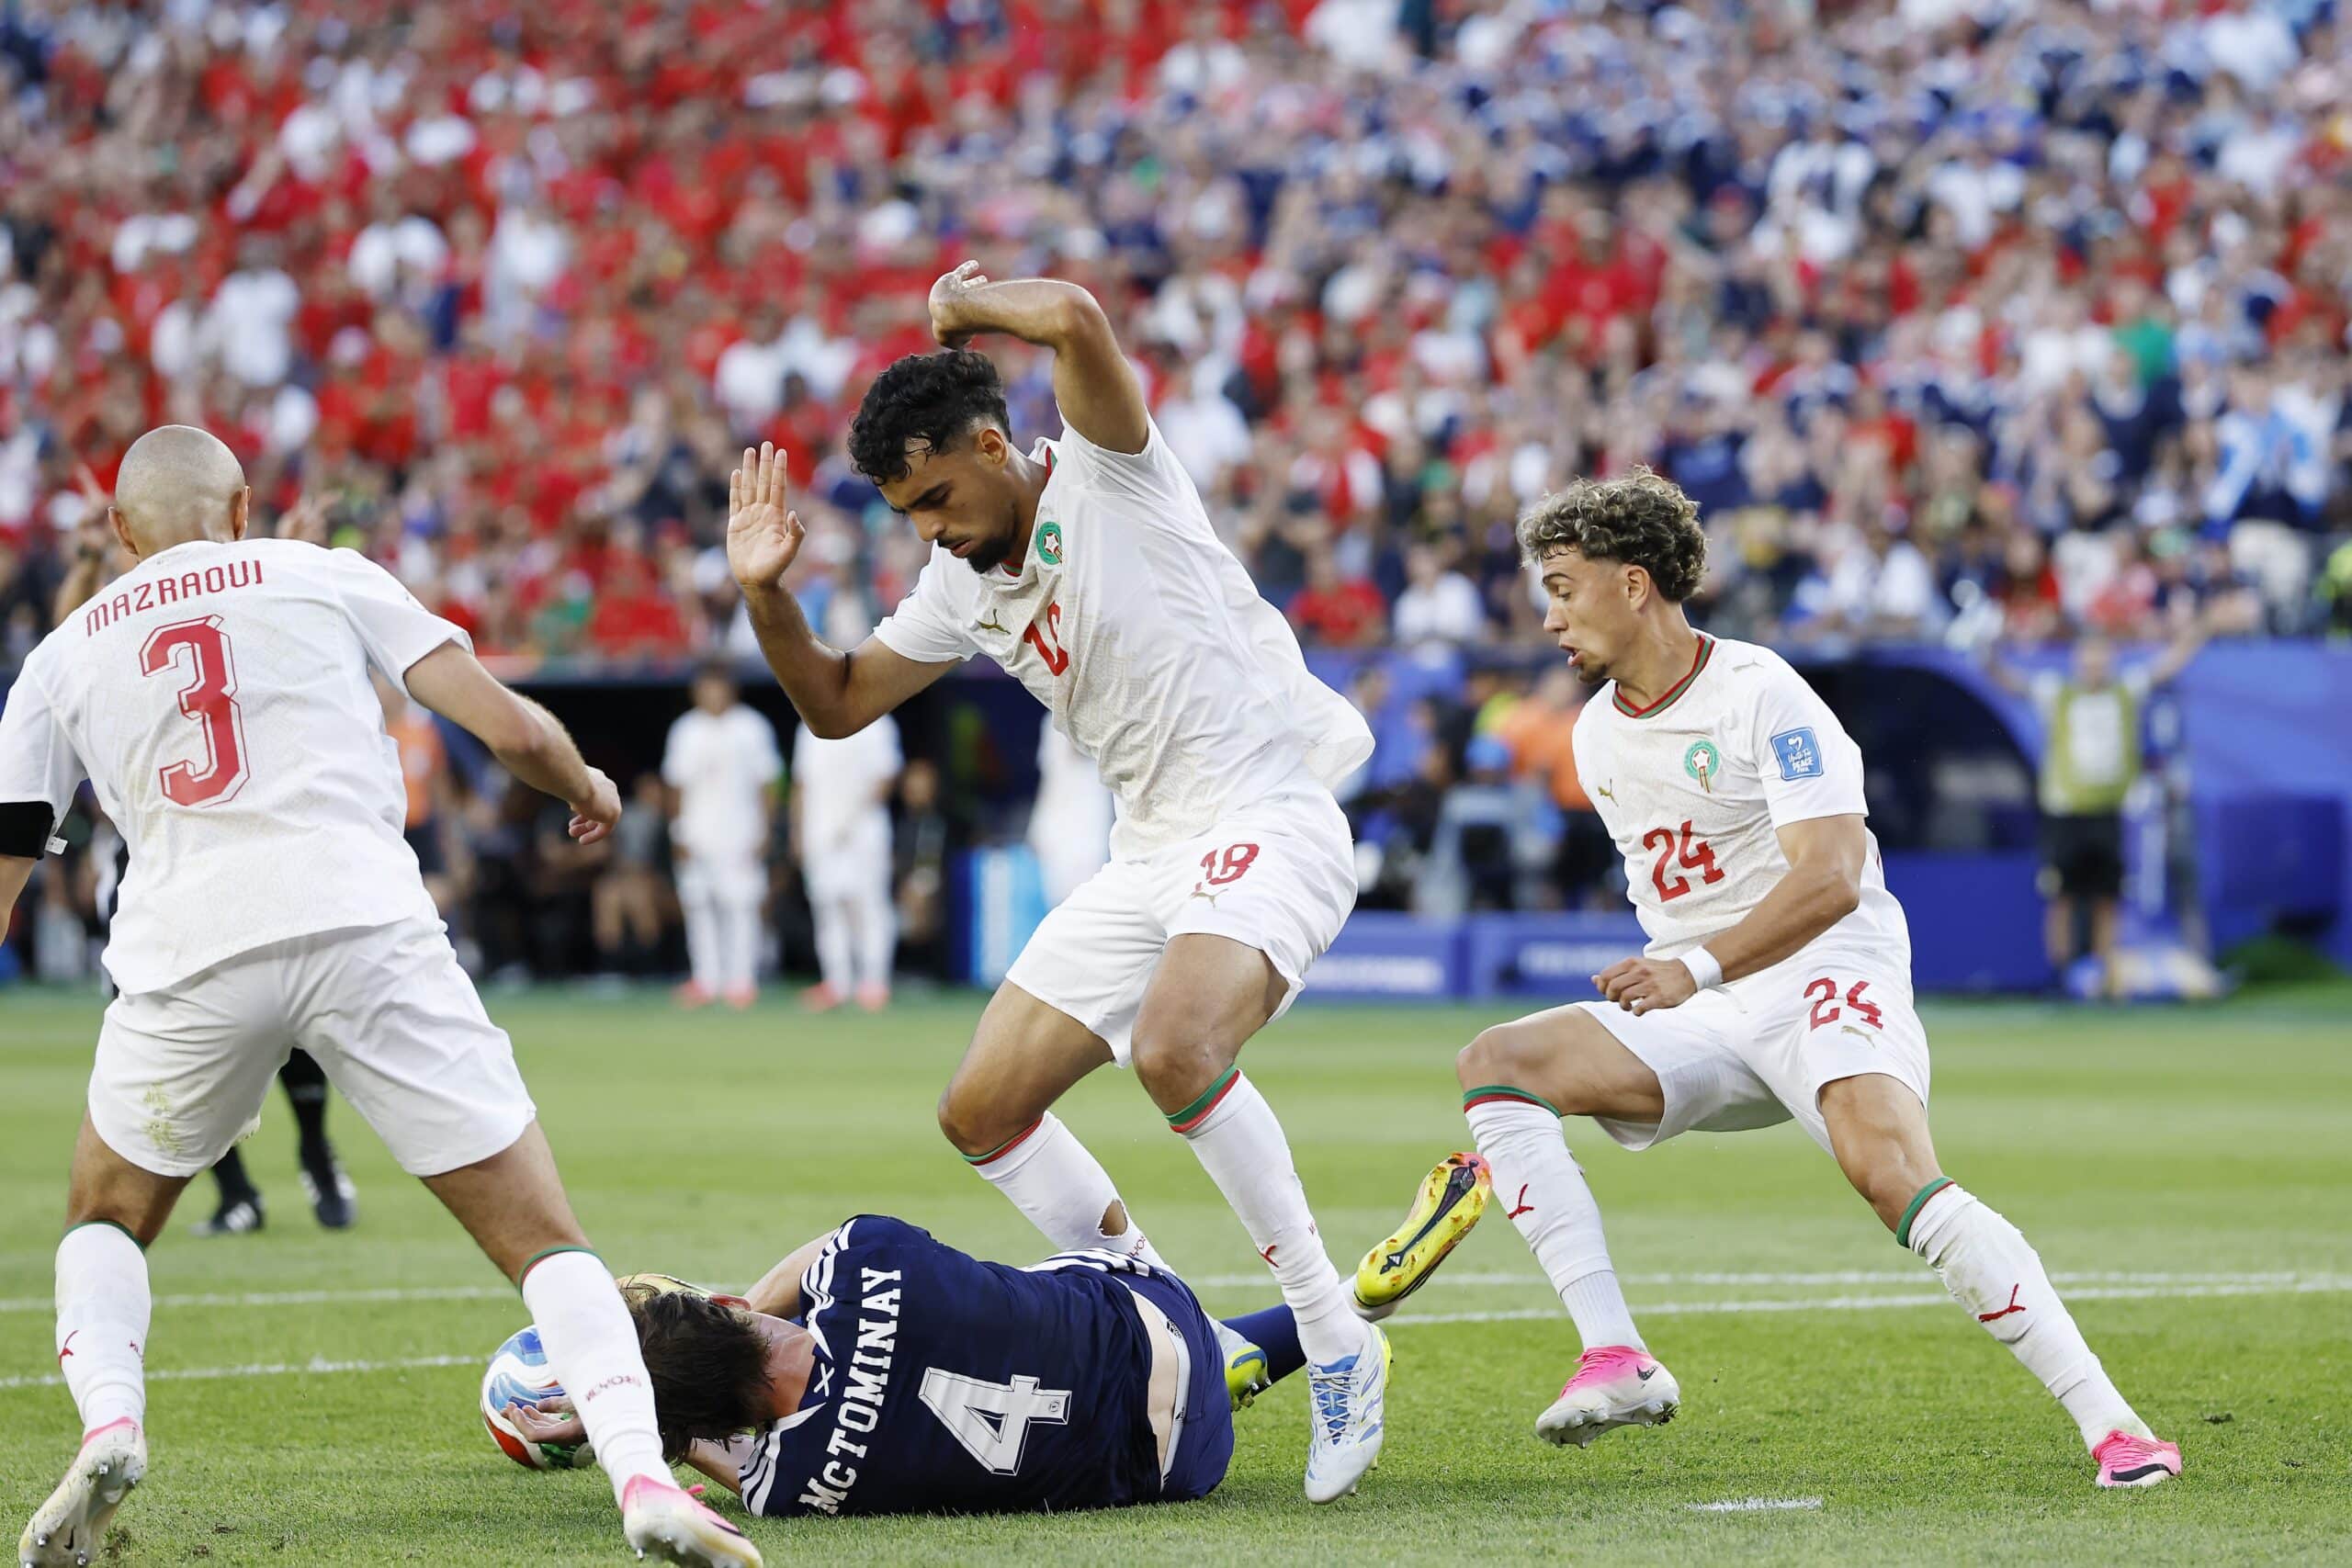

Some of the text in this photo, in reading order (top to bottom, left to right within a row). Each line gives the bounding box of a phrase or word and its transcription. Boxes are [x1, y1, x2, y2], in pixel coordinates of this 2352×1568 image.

[85, 559, 264, 637] MAZRAOUI
[139, 614, 251, 808] 3
[1643, 819, 1725, 902] 24
[1804, 976, 1883, 1032] 24
[797, 1266, 902, 1516] MCTOMINAY
[918, 1367, 1072, 1476] 4
